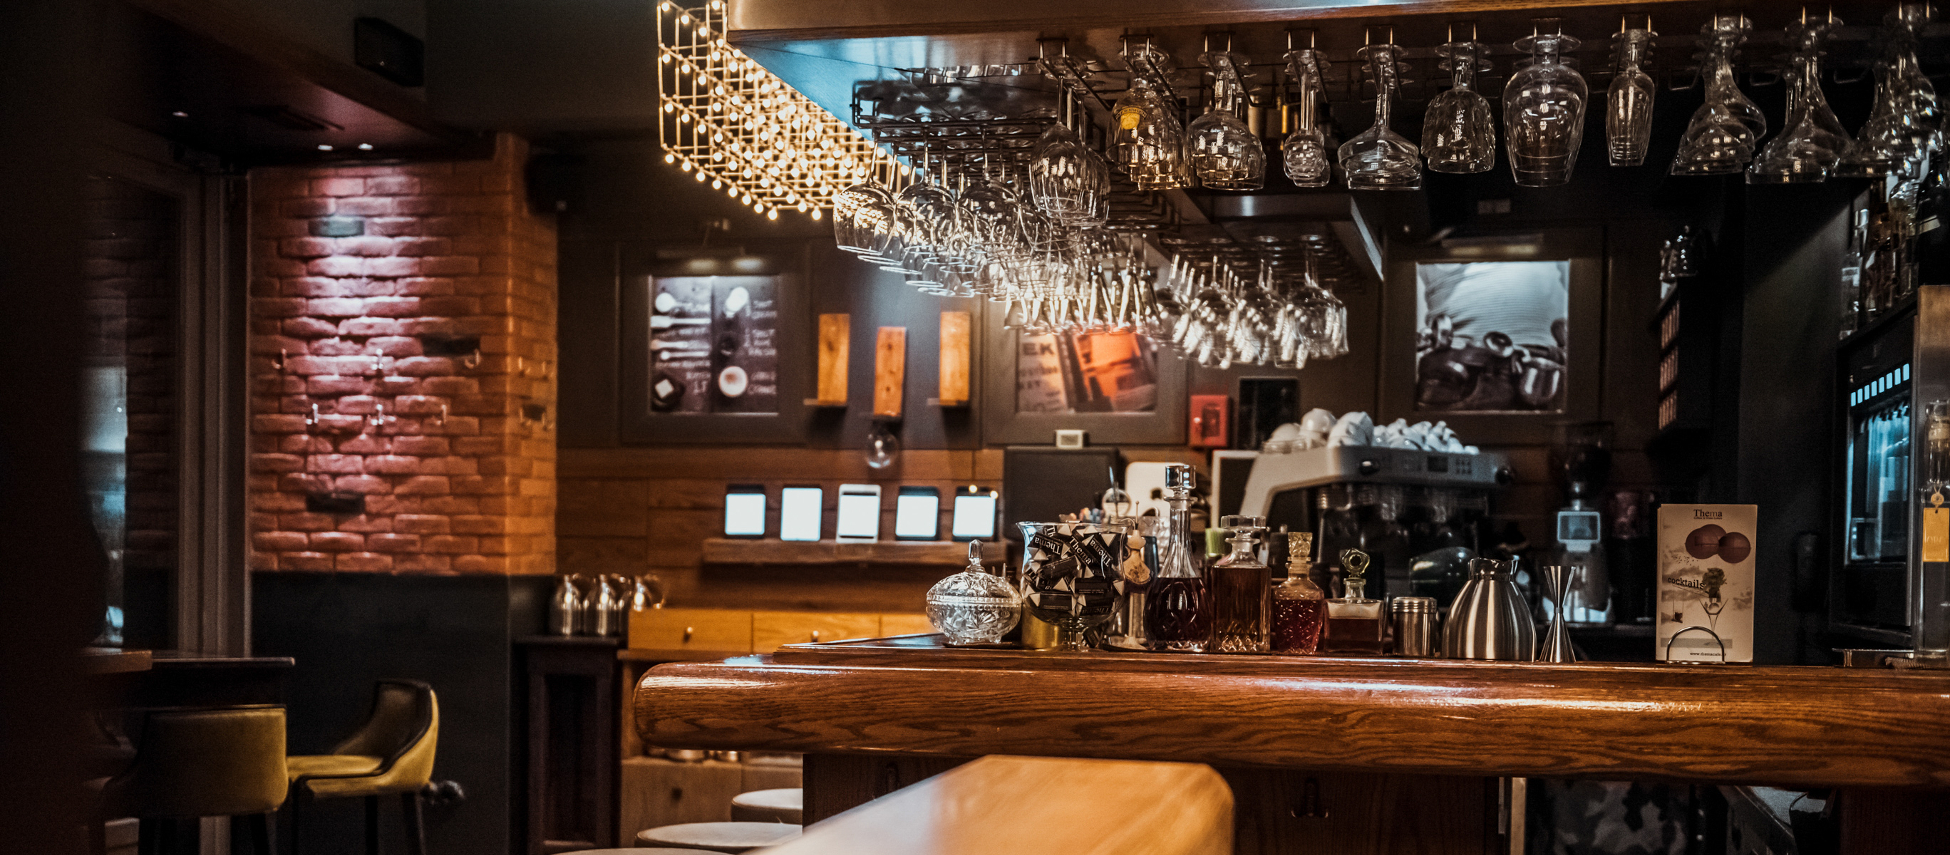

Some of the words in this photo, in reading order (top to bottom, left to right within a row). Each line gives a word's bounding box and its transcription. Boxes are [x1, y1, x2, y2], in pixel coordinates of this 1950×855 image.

[1693, 509, 1722, 517] Thema
[1034, 537, 1061, 555] Thema
[1069, 536, 1092, 565] Thema
[1089, 539, 1111, 567] Thema
[1667, 577, 1705, 589] cocktails
